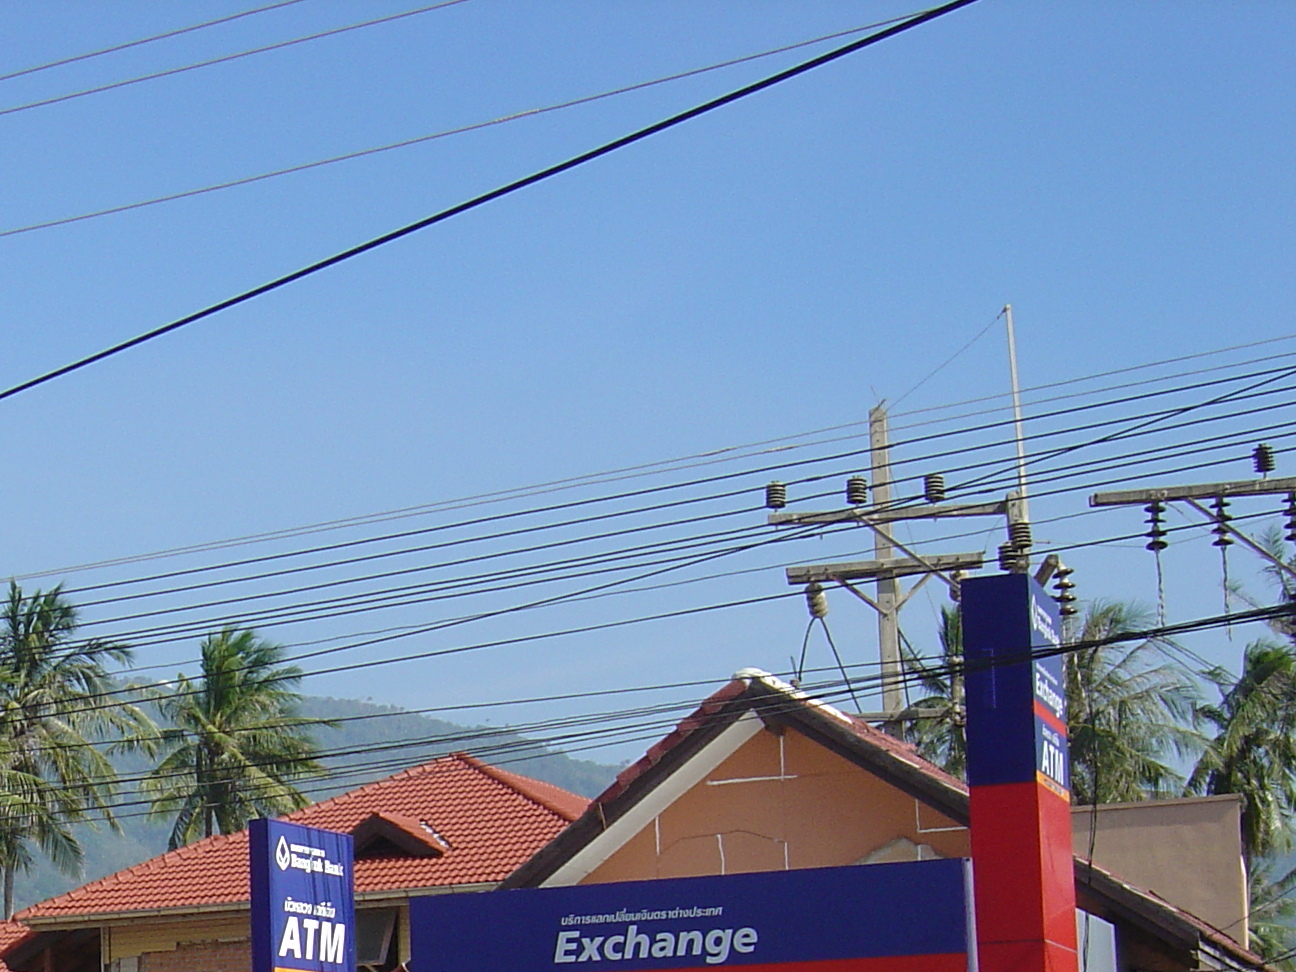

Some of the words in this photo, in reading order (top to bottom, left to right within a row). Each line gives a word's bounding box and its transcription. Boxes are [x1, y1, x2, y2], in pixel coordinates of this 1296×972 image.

[1042, 740, 1063, 785] ATM
[324, 860, 344, 876] Bank
[278, 916, 346, 964] ATM
[554, 924, 759, 964] Exchange
